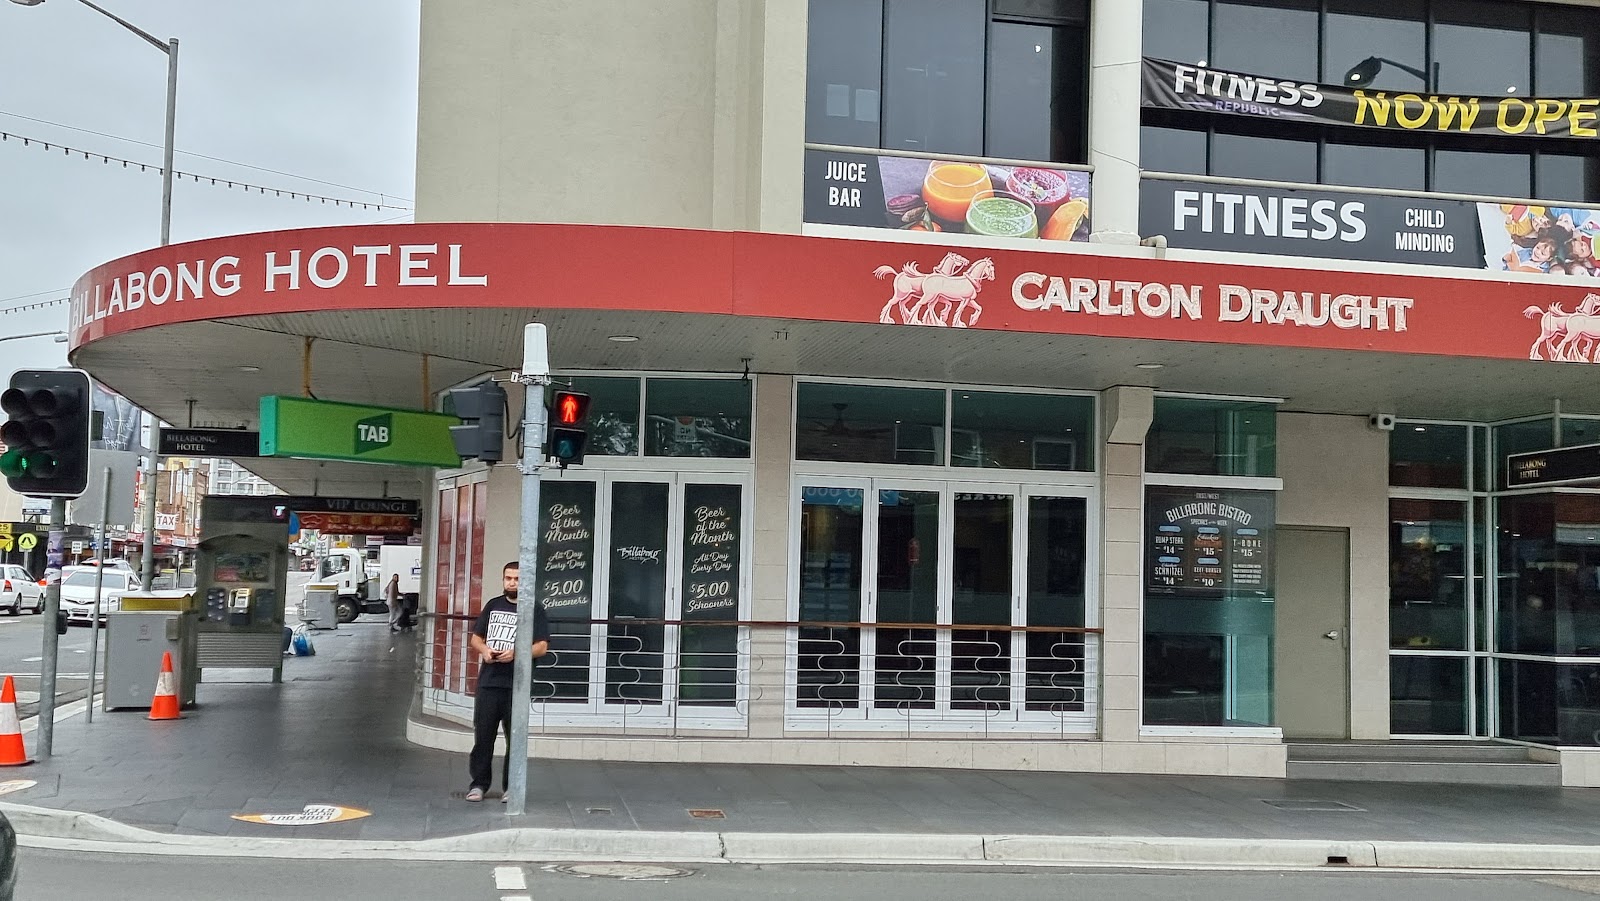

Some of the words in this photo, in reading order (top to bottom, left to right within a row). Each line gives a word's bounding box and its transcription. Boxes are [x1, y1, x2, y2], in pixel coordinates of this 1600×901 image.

[1174, 64, 1324, 108] FITNESS
[1214, 100, 1280, 117] REPUBLIC
[1353, 90, 1480, 132] NOW
[1496, 98, 1600, 137] OPE
[824, 160, 867, 183] JUICE
[828, 186, 861, 208] BAR
[1173, 190, 1368, 242] FITNESS
[1404, 207, 1445, 229] CHILD
[1395, 231, 1454, 254] MINDING
[71, 255, 242, 331] BILLABONG
[264, 243, 488, 292] HOTEL
[1011, 271, 1203, 321] CARLTON
[1218, 284, 1414, 333] DRAUGHT
[166, 434, 216, 443] BILLABONG
[357, 424, 389, 443] TAB
[176, 443, 206, 452] HOTEL
[326, 499, 350, 510] VIP
[354, 500, 408, 512] LOUNGE
[549, 503, 581, 520] Beer
[694, 505, 726, 522] Beer
[157, 515, 175, 526] TAX
[1165, 502, 1217, 523] BILLABONG
[1218, 503, 1252, 526] BISTRO
[550, 518, 562, 533] of
[563, 517, 582, 528] the
[696, 520, 708, 535] of
[708, 519, 727, 531] the
[544, 529, 590, 543] Month
[690, 531, 735, 546] Month
[564, 549, 583, 560] Day
[709, 551, 729, 562] Day
[1203, 547, 1215, 556] $15
[1241, 548, 1253, 557] $15
[544, 561, 566, 572] Every
[566, 559, 586, 570] Day
[691, 564, 712, 574] Every
[712, 561, 732, 571] Day
[1154, 566, 1184, 576] SCHNITZEL
[544, 579, 583, 597] $5.00
[690, 581, 729, 599] $5.00
[1201, 578, 1214, 587] $10
[541, 596, 588, 610] Schooners
[686, 598, 734, 613] Schooners
